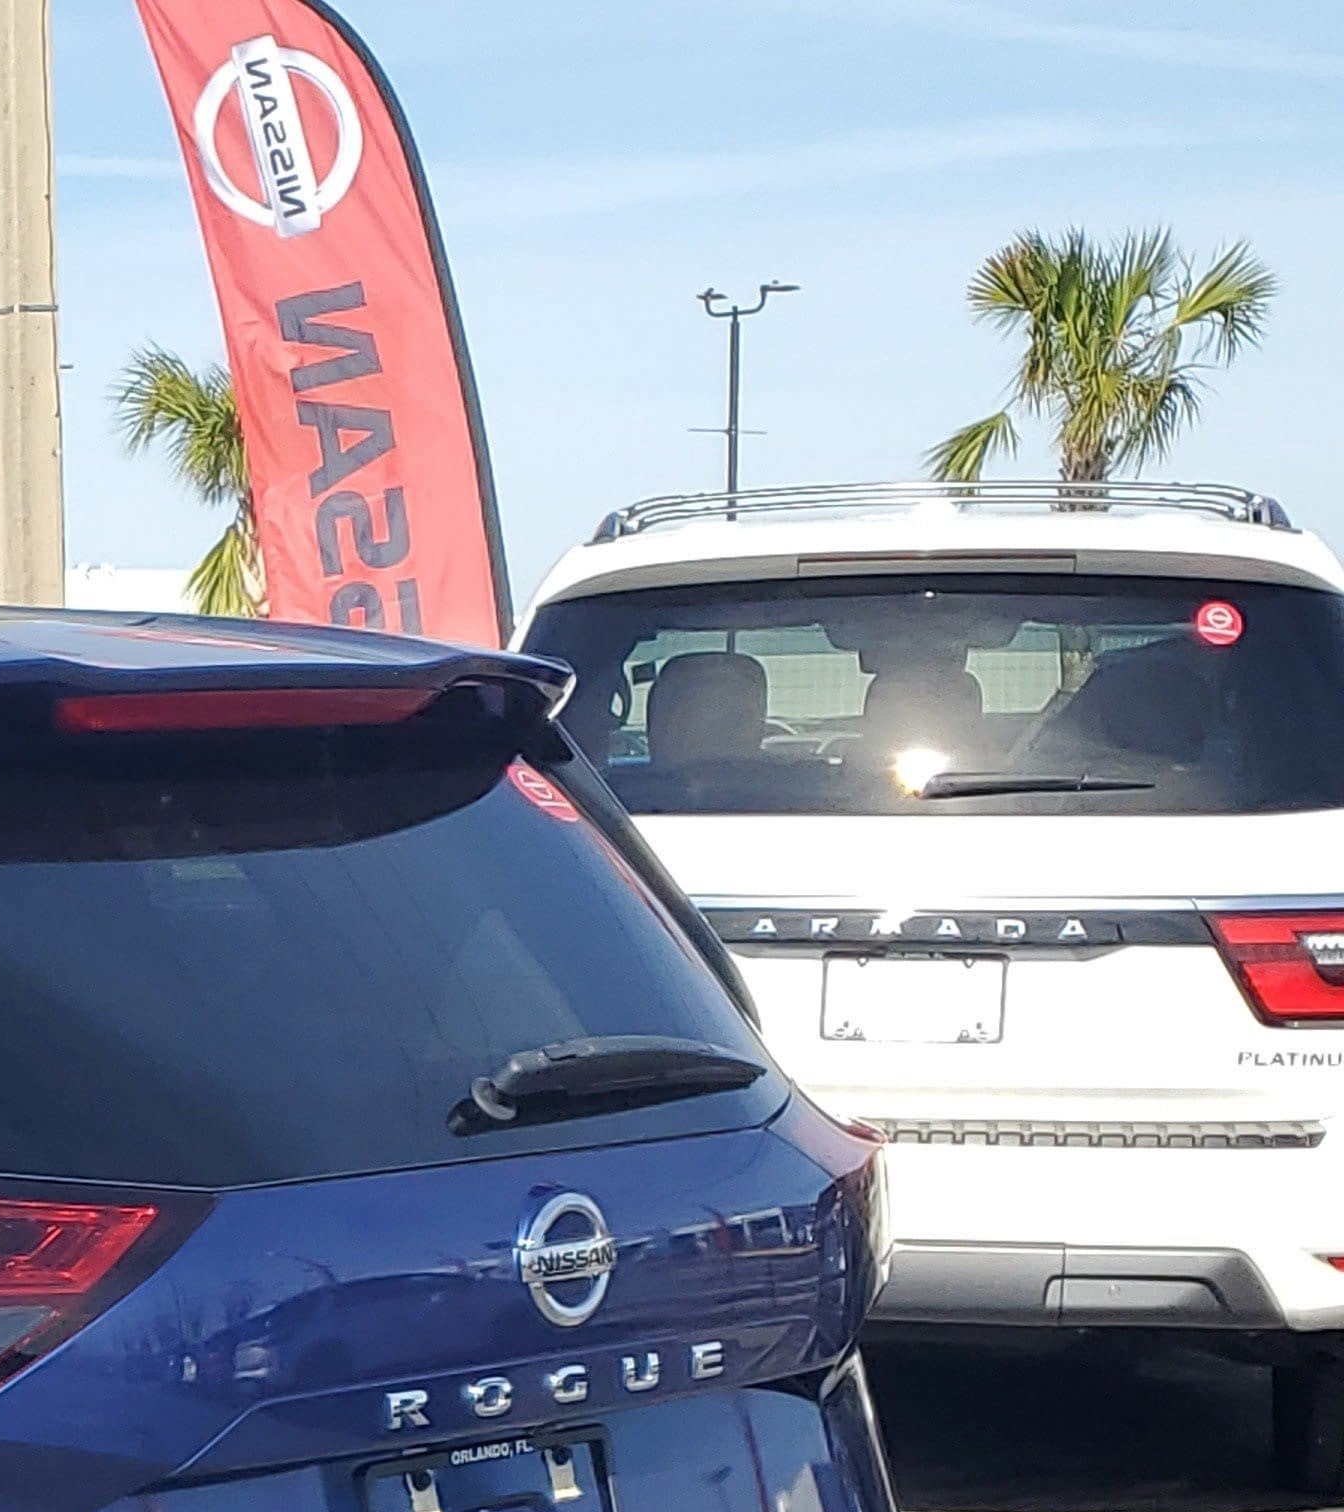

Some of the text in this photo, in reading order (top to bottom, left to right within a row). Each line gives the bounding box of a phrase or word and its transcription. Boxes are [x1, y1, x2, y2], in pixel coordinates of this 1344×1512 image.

[751, 917, 1088, 940] ARMADA
[534, 1243, 614, 1274] NISSAN
[385, 1340, 726, 1431] ROGUE
